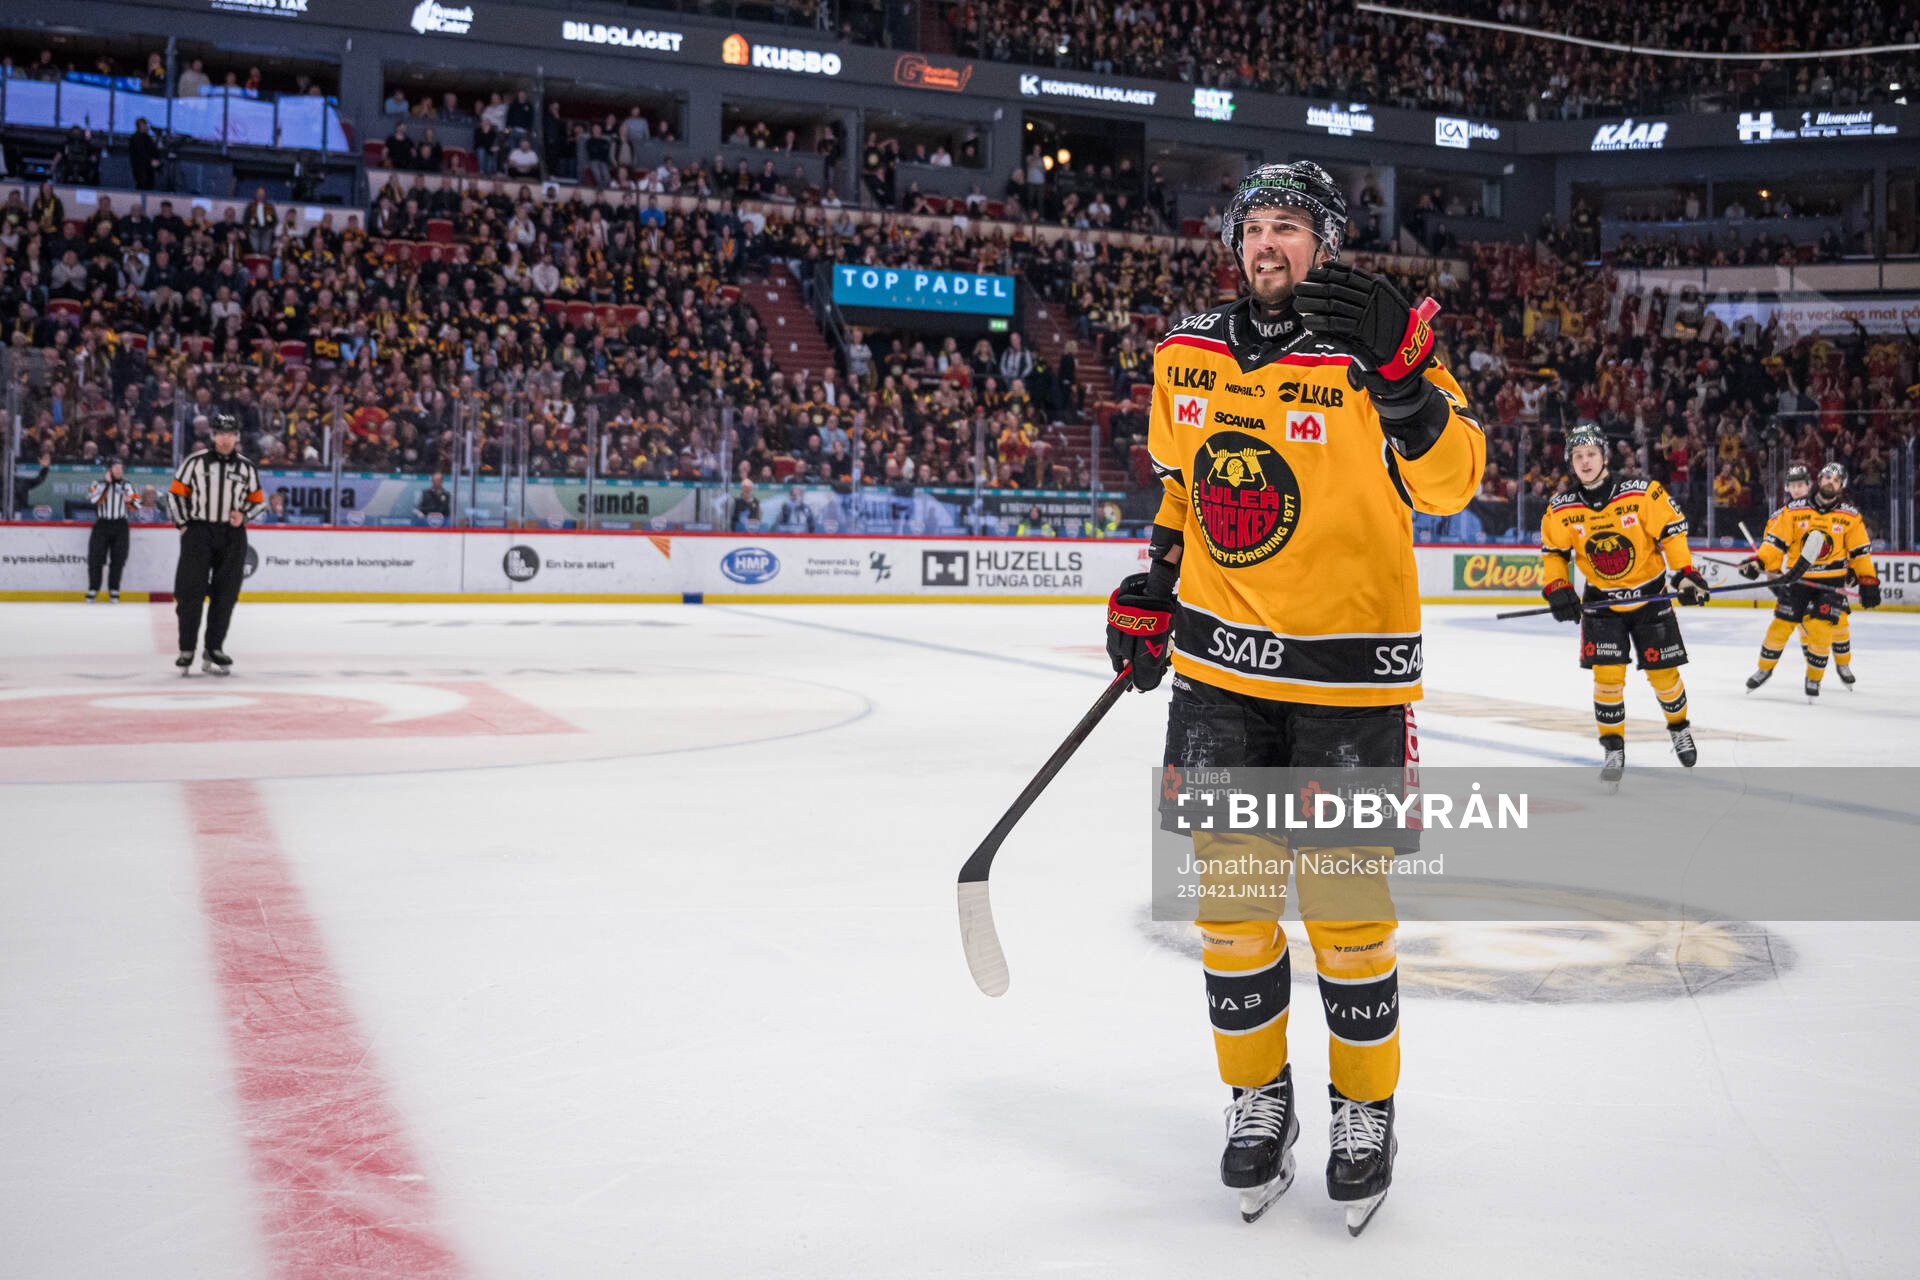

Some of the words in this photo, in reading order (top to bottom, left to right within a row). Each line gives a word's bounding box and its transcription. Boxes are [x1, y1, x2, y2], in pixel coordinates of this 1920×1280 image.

[562, 20, 683, 52] BILBOLAGET
[752, 44, 841, 75] KUSBO
[1041, 79, 1157, 105] KONTROLLBOLAGET
[1439, 122, 1463, 138] ICA
[1468, 123, 1499, 140] Järbo
[842, 269, 899, 290] TOP
[914, 274, 1006, 298] PADEL
[1869, 307, 1897, 321] mat
[1174, 367, 1217, 391] LKAB
[1300, 383, 1343, 408] LKAB
[1214, 411, 1266, 430] SCANIA
[1200, 479, 1279, 510] LULEÅ
[1619, 479, 1648, 492] SSAB
[577, 491, 650, 514] sunda
[1283, 494, 1295, 523] 1977
[1201, 501, 1279, 549] HOCKEY
[294, 556, 354, 570] schyssta
[357, 557, 415, 571] kompisar
[546, 559, 561, 569] En
[564, 559, 584, 569] bra
[586, 560, 616, 570] start
[734, 556, 770, 571] HMP
[976, 552, 1083, 571] HUZELLS
[976, 574, 1028, 588] TUNGA
[1033, 575, 1083, 588] DELAR
[1208, 626, 1285, 669] SSAB
[1374, 643, 1422, 676] SSA
[1186, 768, 1231, 785] Luleå
